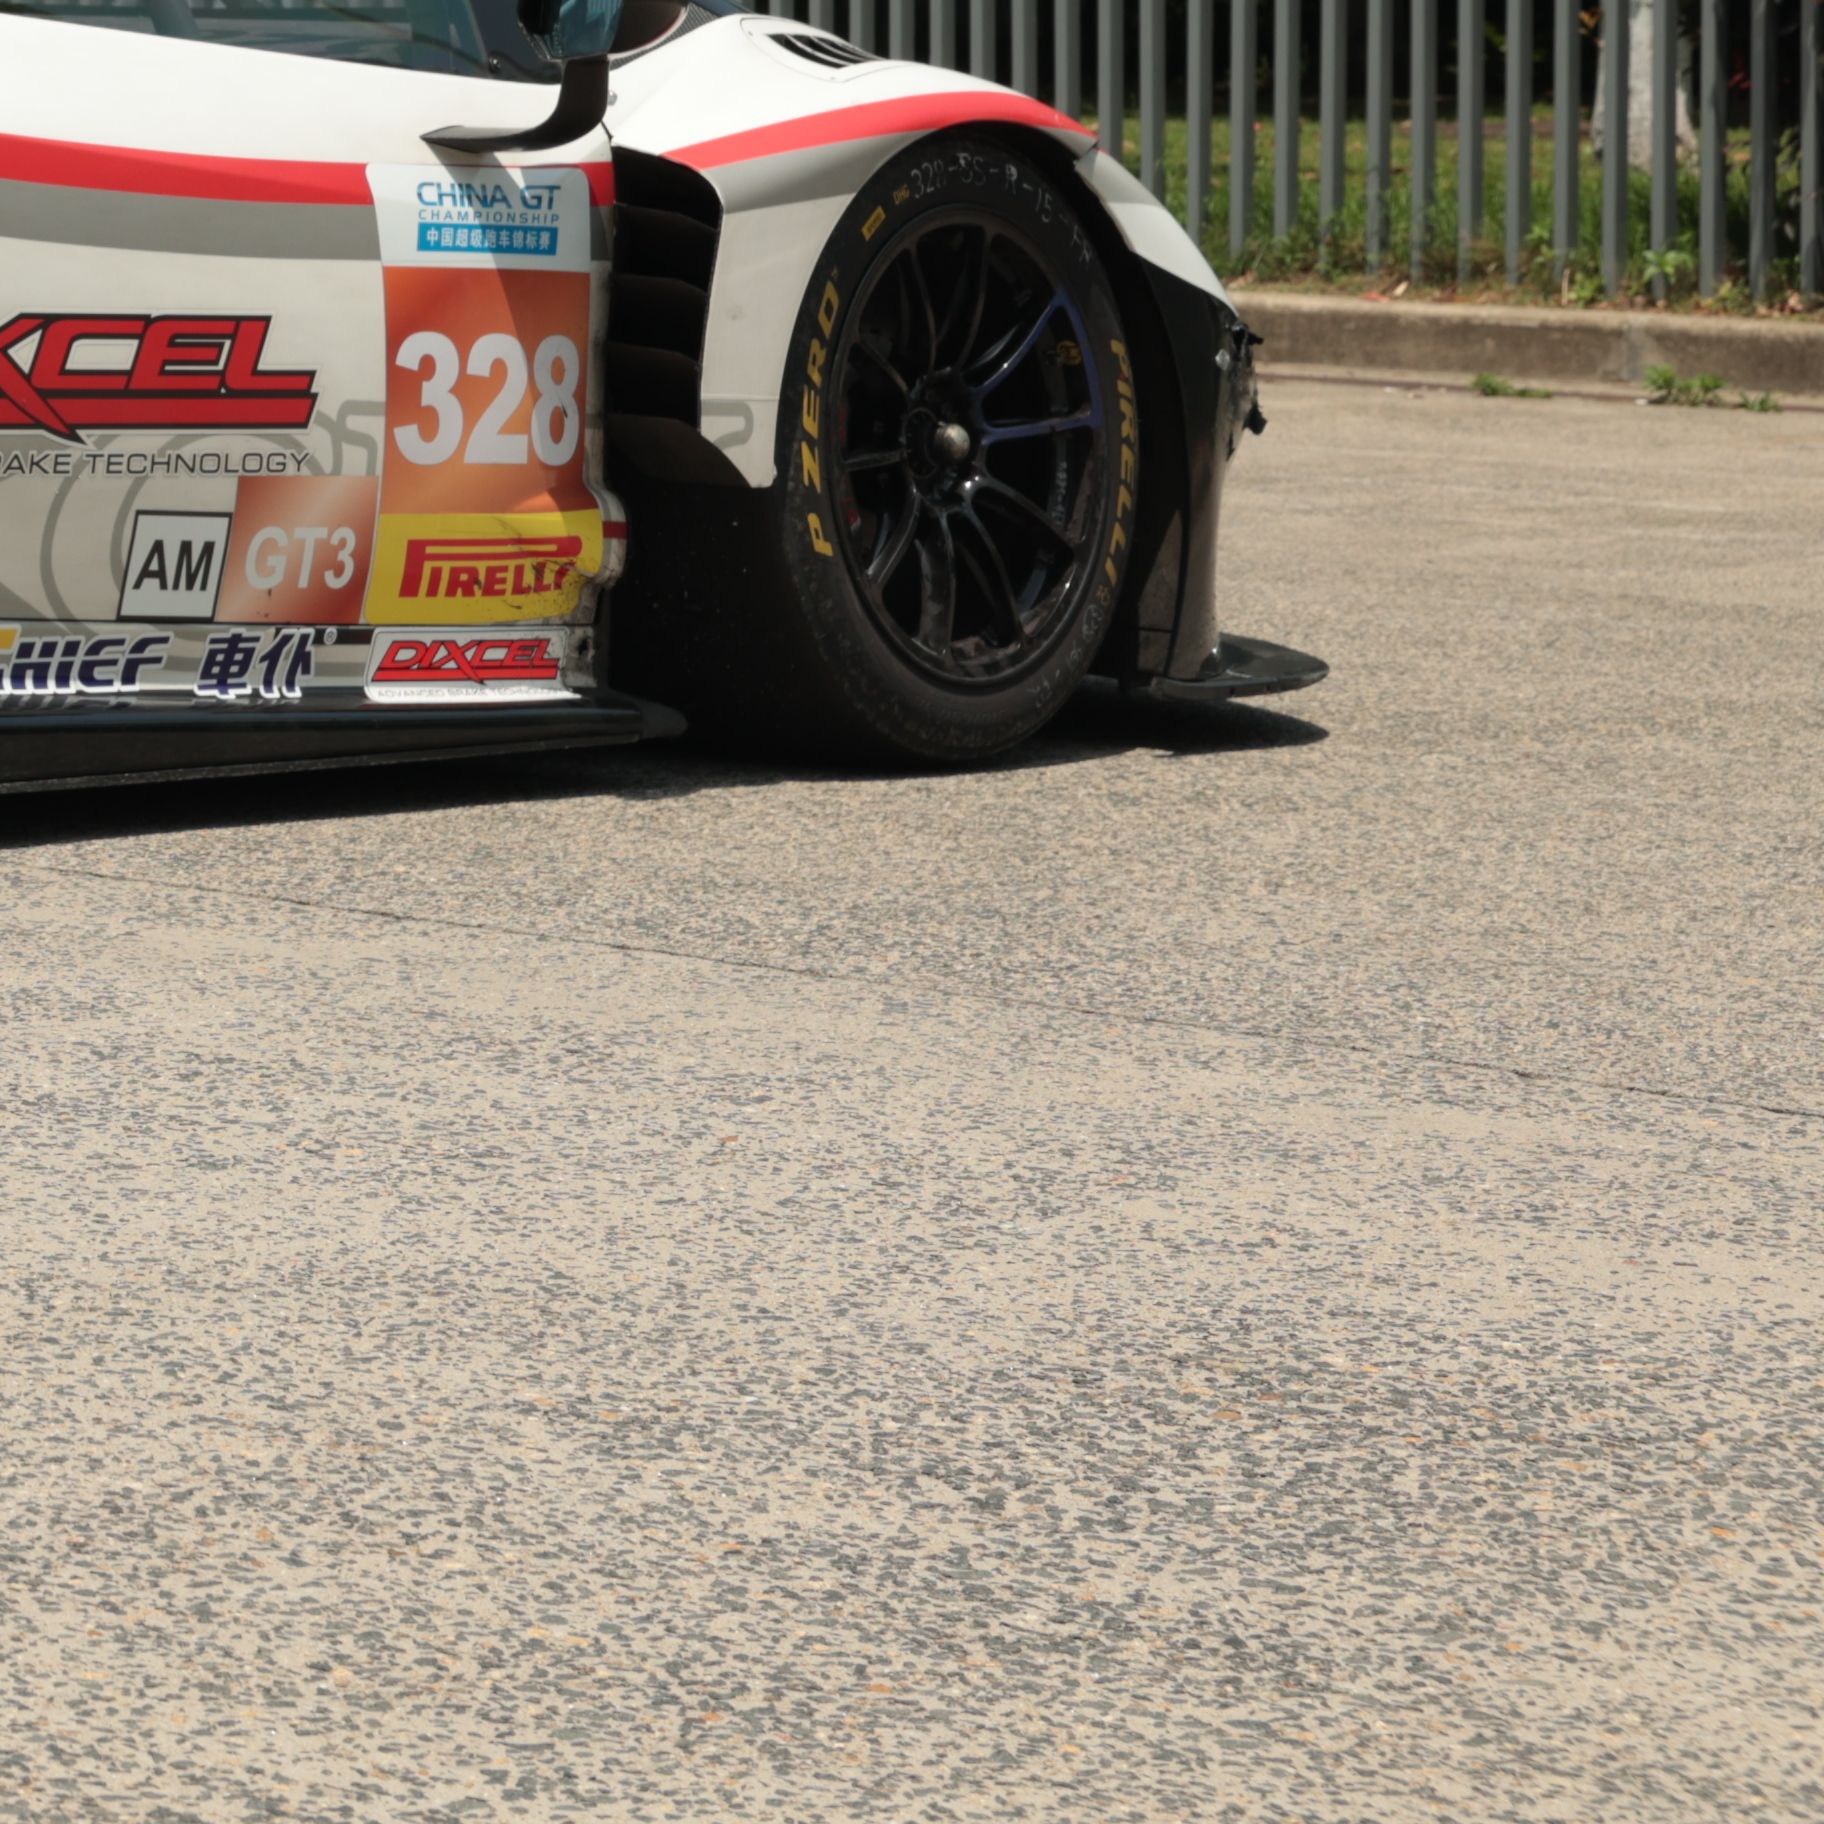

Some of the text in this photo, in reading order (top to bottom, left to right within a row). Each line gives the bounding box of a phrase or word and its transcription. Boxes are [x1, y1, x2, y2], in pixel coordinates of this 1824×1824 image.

[416, 181, 561, 211] CHINA GT
[418, 209, 560, 225] CHAMPIONSHIP
[392, 330, 581, 467] 328
[801, 279, 840, 557] P ZERO
[88, 451, 312, 475] TECHNOLOGY
[132, 539, 216, 592] AM
[244, 526, 357, 591] GT3
[371, 639, 560, 686] DIXCEL
